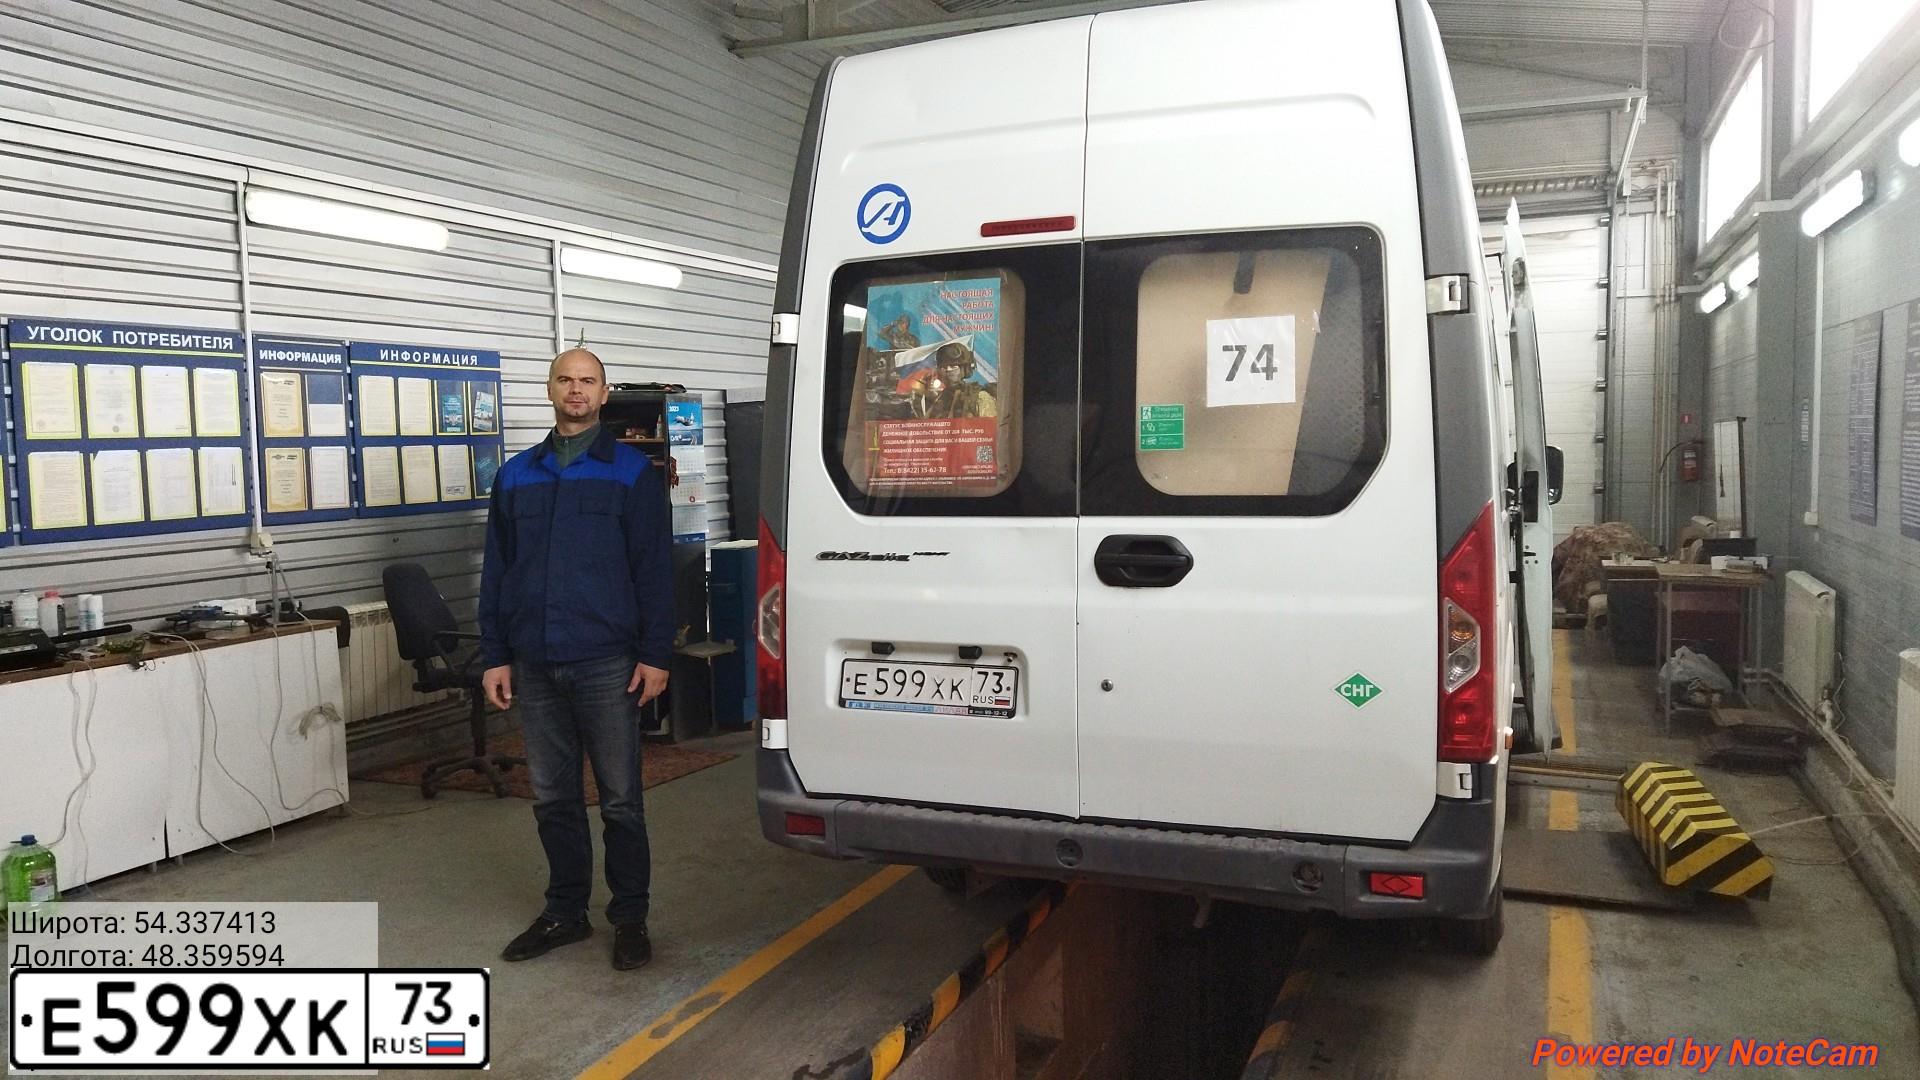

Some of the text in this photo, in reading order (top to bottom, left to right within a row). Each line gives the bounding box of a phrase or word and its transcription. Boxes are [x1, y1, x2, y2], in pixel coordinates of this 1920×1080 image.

[962, 301, 994, 310] РАБОТА
[26, 325, 233, 350] УГОЛОК ПОТРЕБИТЕЛЯ
[259, 349, 342, 365] ИНФОРМАЦИЯ
[379, 349, 478, 366] ИНФОРМАЦИЯ
[1222, 343, 1278, 382] 74
[977, 671, 1005, 694] 73
[1340, 683, 1374, 697] СНГ
[972, 695, 994, 704] RUS
